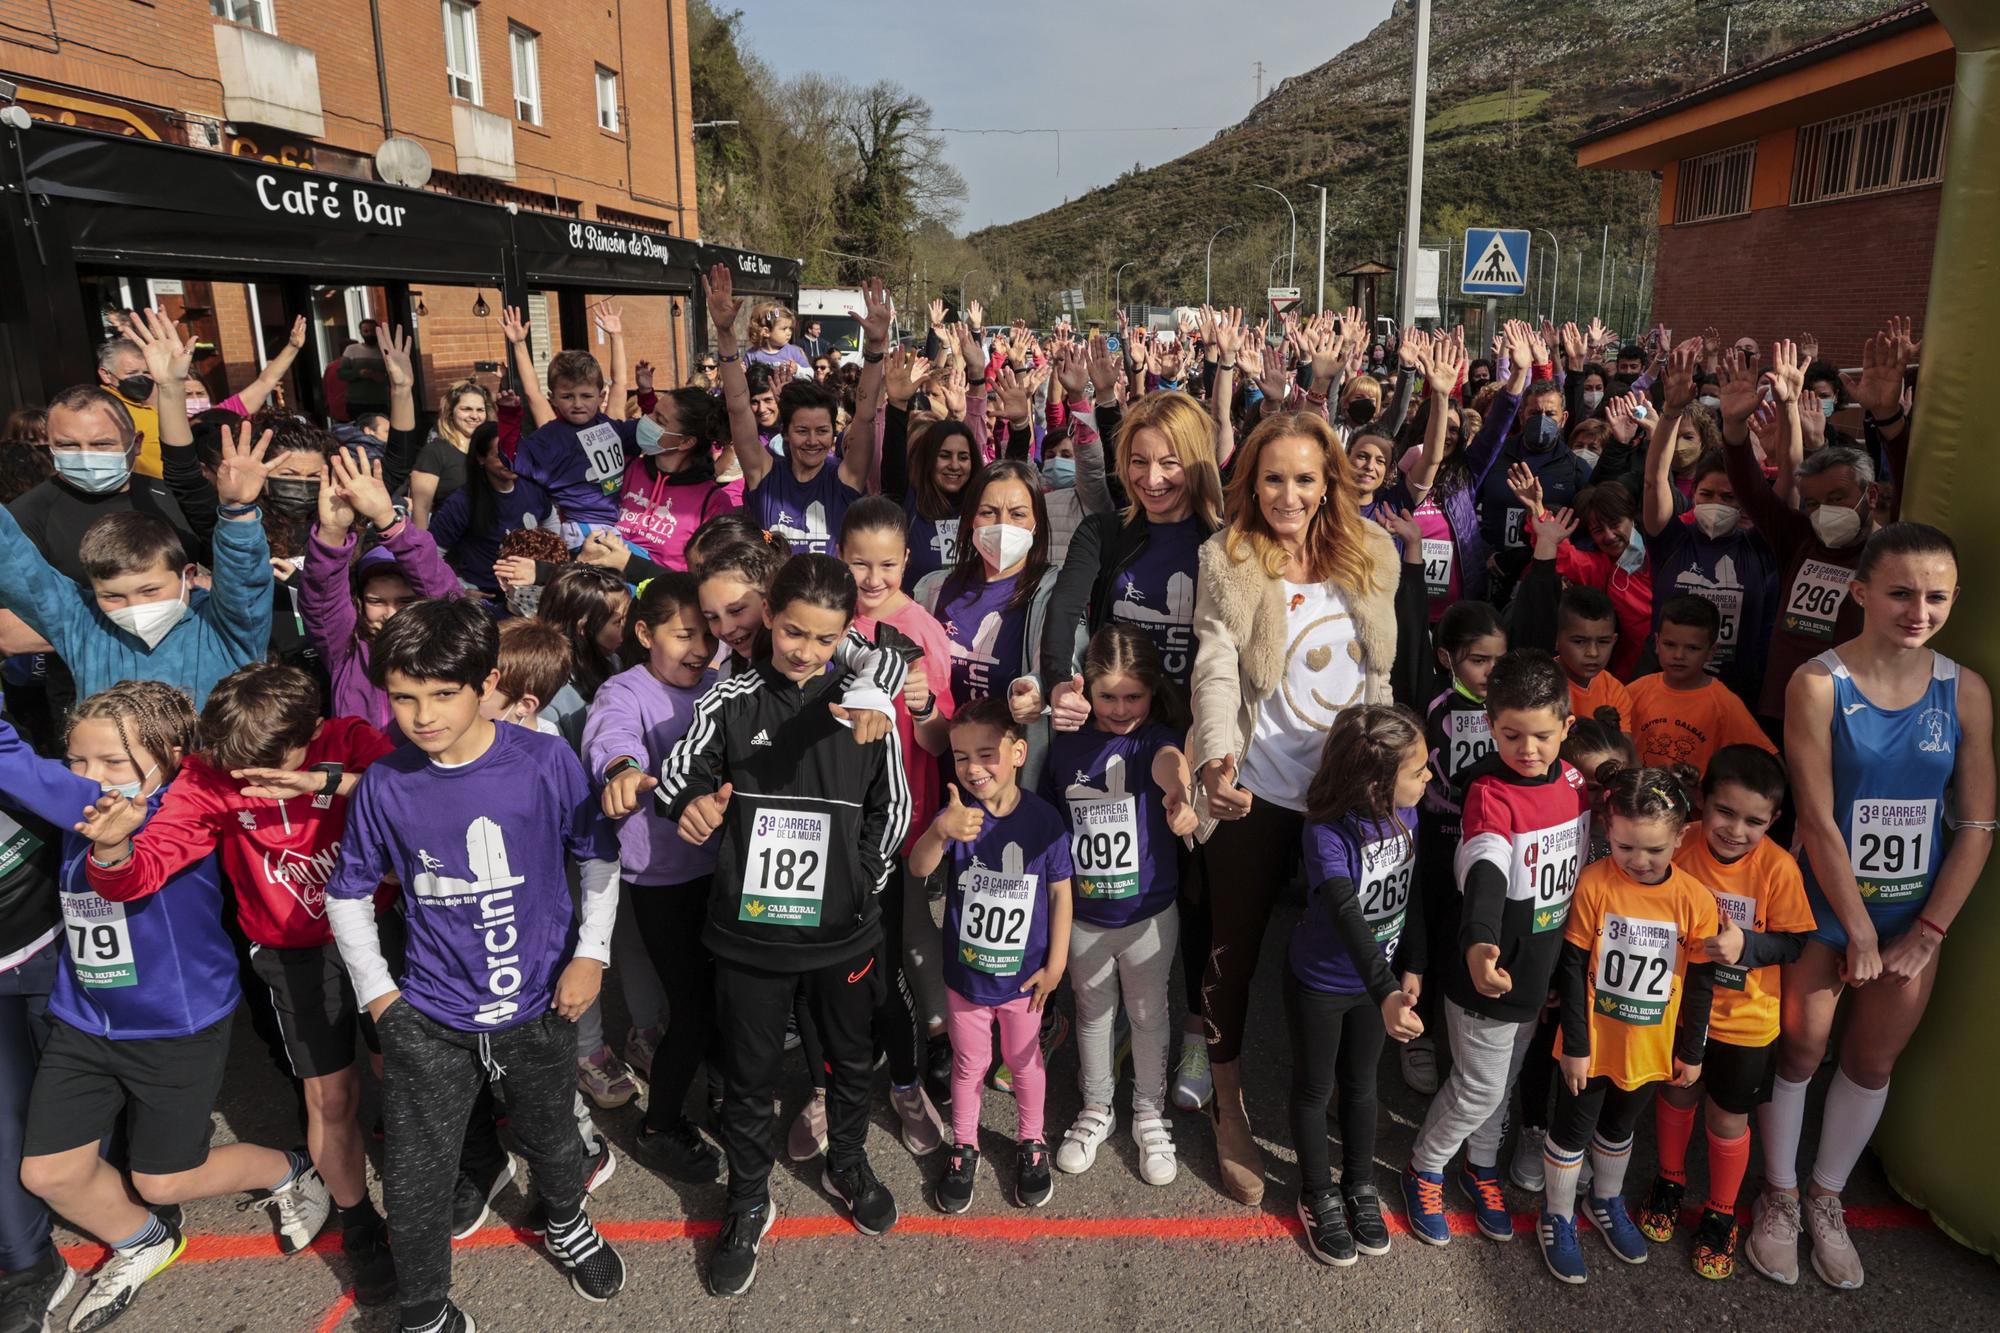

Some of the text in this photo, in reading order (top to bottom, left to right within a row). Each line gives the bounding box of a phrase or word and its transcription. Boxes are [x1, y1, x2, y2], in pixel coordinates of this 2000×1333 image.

[352, 189, 406, 227] Bar
[568, 223, 669, 265] El Rincón de Deny
[758, 257, 771, 275] Bar
[593, 443, 623, 474] 018
[1425, 559, 1449, 581] 47
[1820, 566, 1850, 579] CARRERA
[1792, 582, 1840, 615] 296
[1089, 802, 1128, 816] CARRERA
[1882, 805, 1927, 818] CARRERA
[778, 817, 822, 832] CARRERA
[1090, 813, 1129, 825] DE LA MUJER
[1882, 816, 1927, 827] DE LA MUJER
[777, 830, 821, 841] DE LA MUJER
[1077, 831, 1132, 870] 092
[1859, 833, 1922, 873] 291
[759, 847, 819, 892] 182
[991, 877, 1029, 891] CARRERA
[1113, 879, 1135, 889] RURAL
[1540, 854, 1578, 901] 048
[1363, 868, 1409, 916] 263
[1880, 881, 1923, 892] CAJA RURAL
[989, 889, 1029, 900] DE LA MUJER
[767, 904, 816, 914] CAJA RURAL
[1716, 896, 1746, 913] RRERA
[72, 908, 81, 918] LA
[82, 907, 113, 918] MUJER
[966, 902, 1026, 944] 302
[1629, 925, 1670, 940] CARRERA
[67, 924, 120, 960] 79
[1628, 936, 1637, 945] DE
[1638, 938, 1647, 946] LA
[1648, 938, 1669, 949] MUJER
[978, 954, 996, 963] CAJA
[94, 969, 130, 979] RURAL
[1604, 949, 1668, 996] 072
[1619, 1003, 1662, 1015] CAJA RURAL
